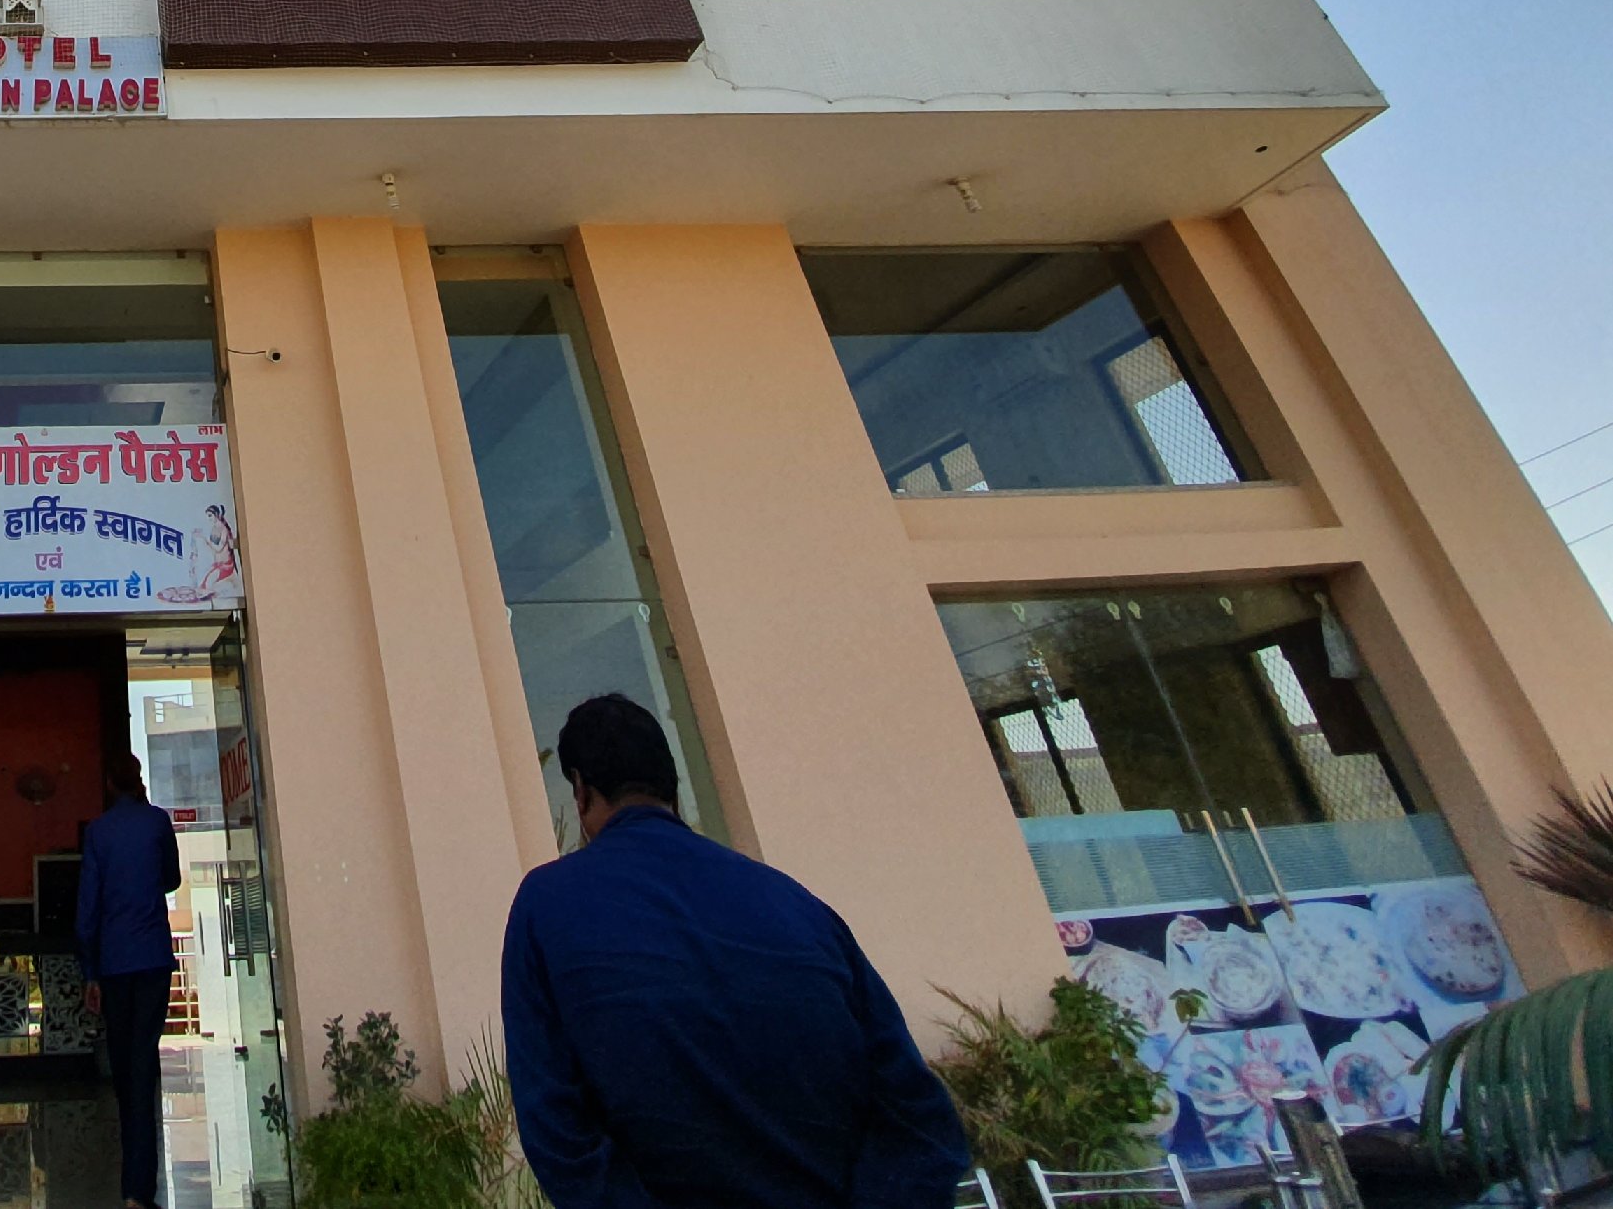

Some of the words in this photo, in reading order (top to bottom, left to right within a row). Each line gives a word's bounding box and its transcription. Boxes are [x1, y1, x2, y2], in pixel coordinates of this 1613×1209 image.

[33, 77, 160, 112] PALACE
[114, 430, 219, 484] पैलेस
[3, 495, 88, 540] हार्दिक
[93, 509, 185, 560] स्वागत
[34, 546, 64, 571] एवं
[60, 579, 119, 599] करता
